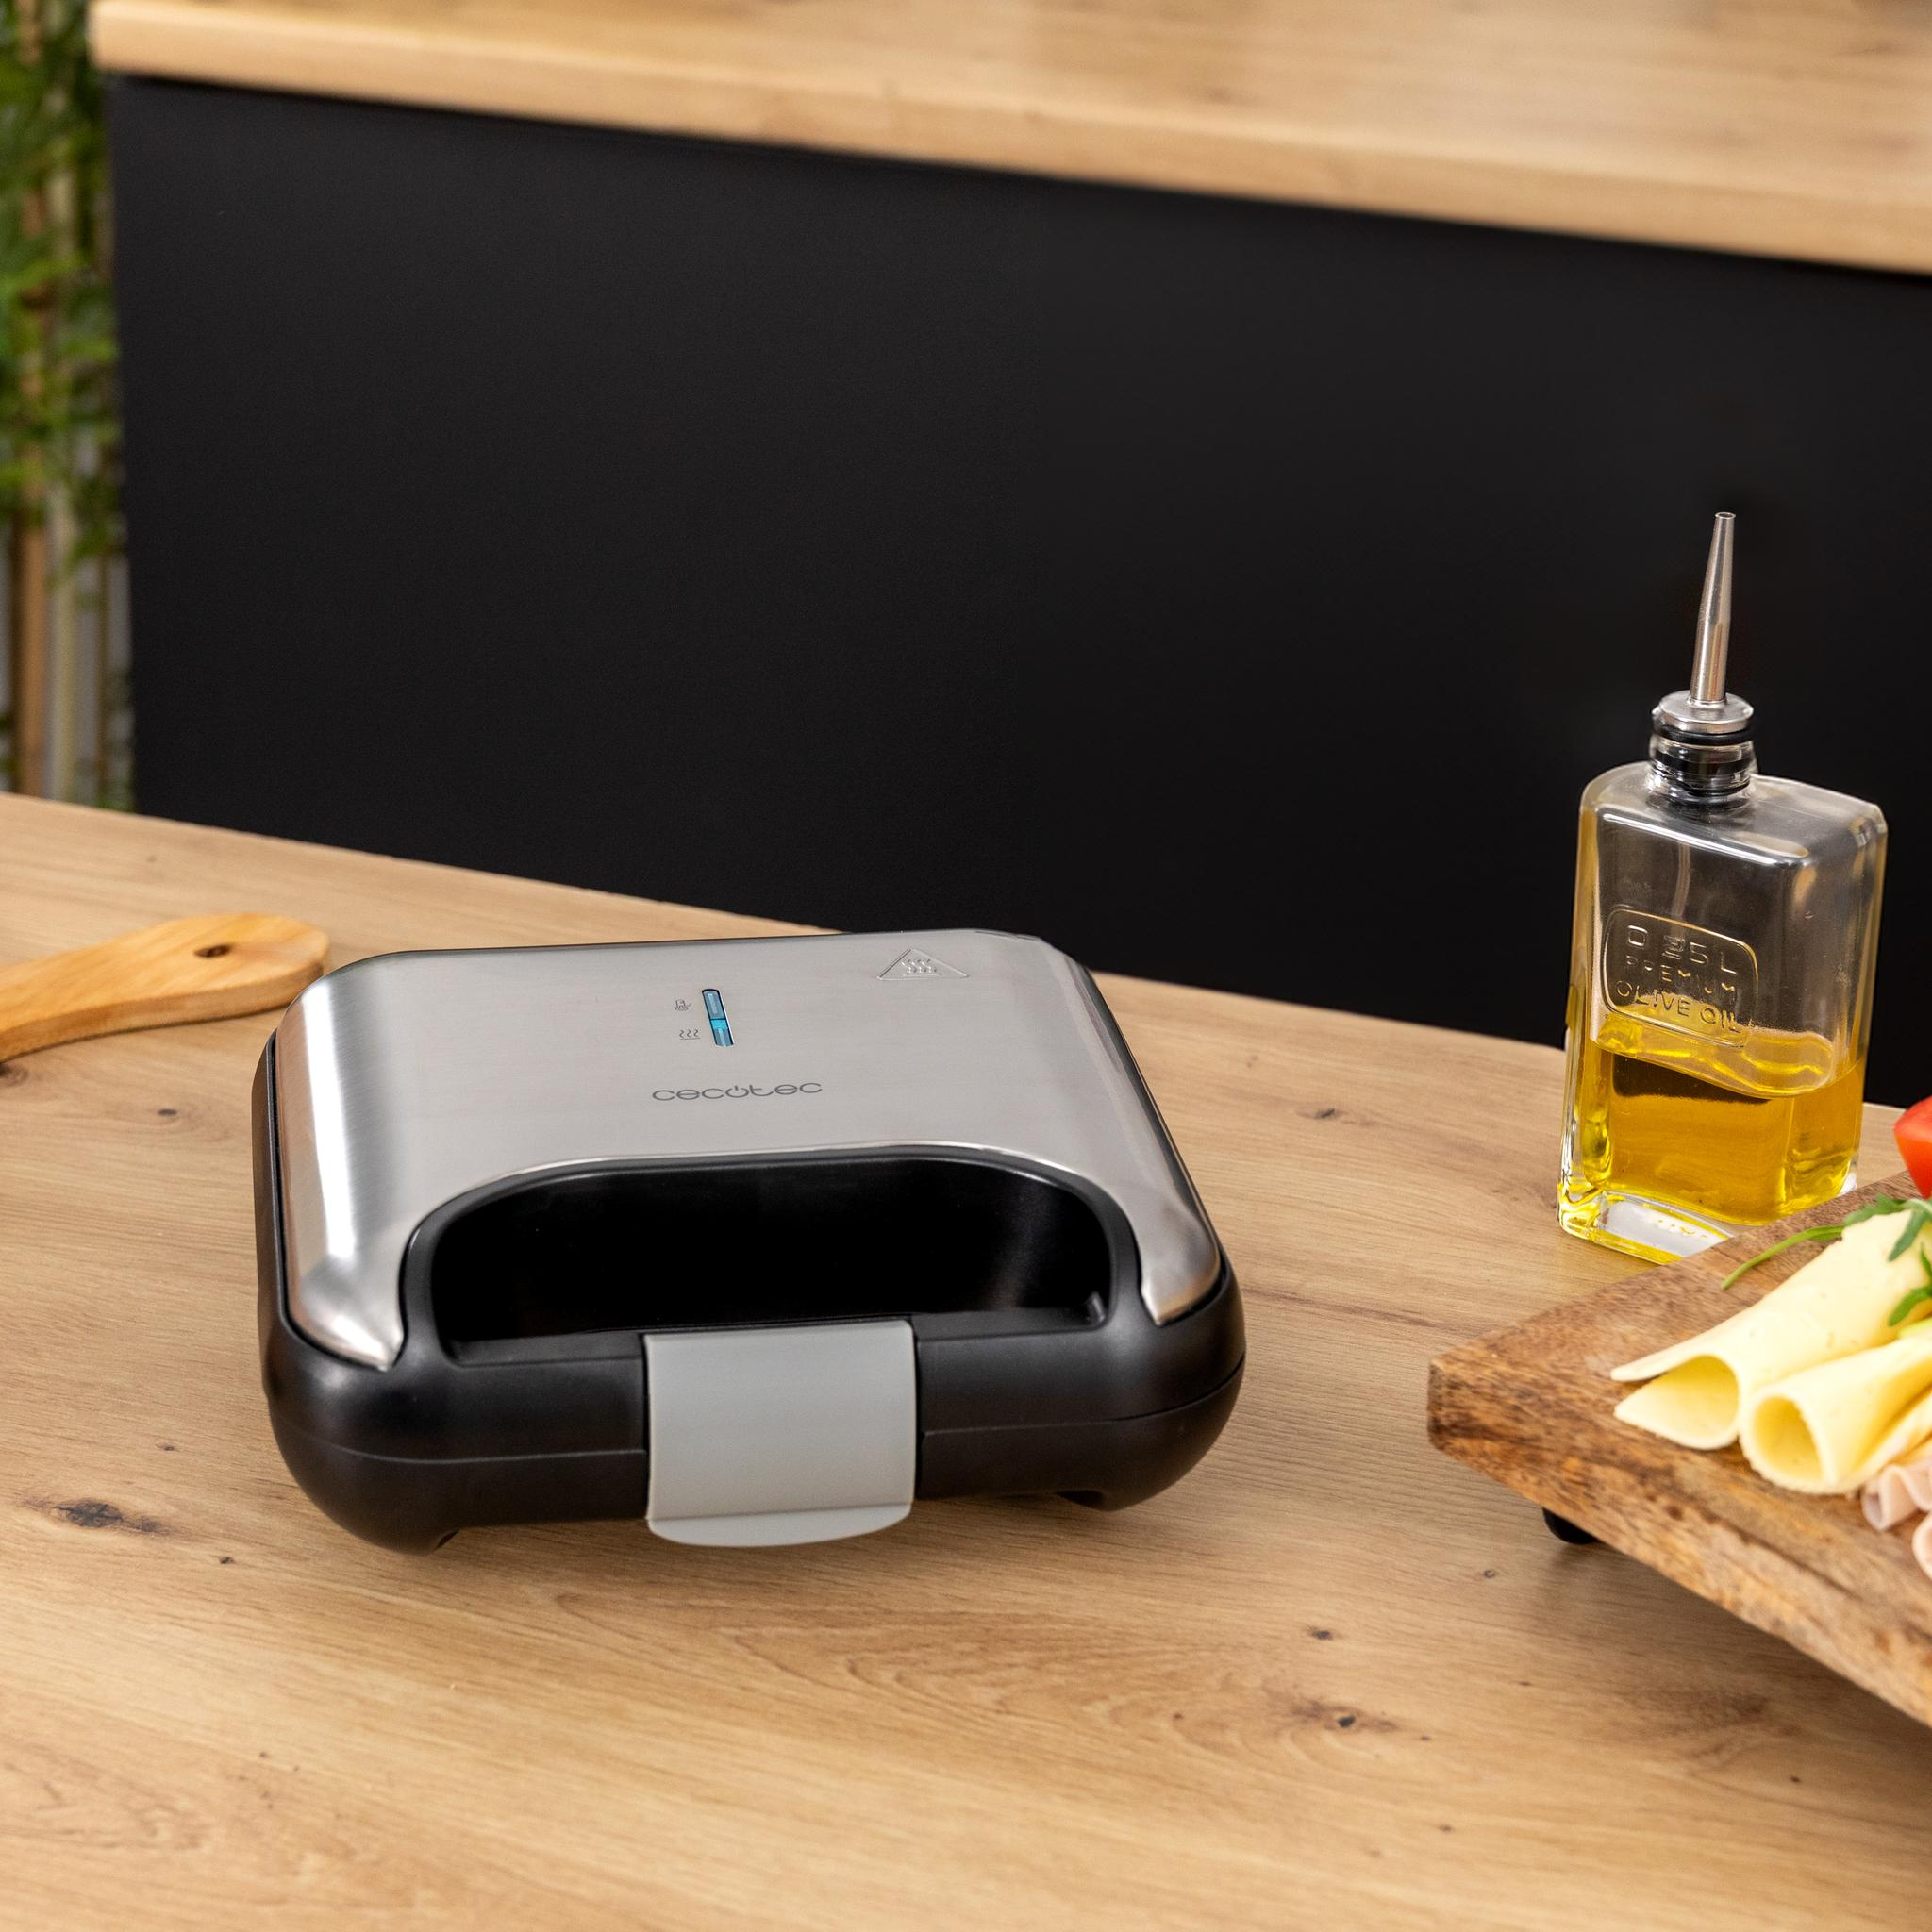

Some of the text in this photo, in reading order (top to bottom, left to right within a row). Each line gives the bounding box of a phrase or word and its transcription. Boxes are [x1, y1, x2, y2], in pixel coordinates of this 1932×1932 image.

[1615, 980, 1741, 1035] OLIVE OIL
[651, 1082, 824, 1102] cecotec
